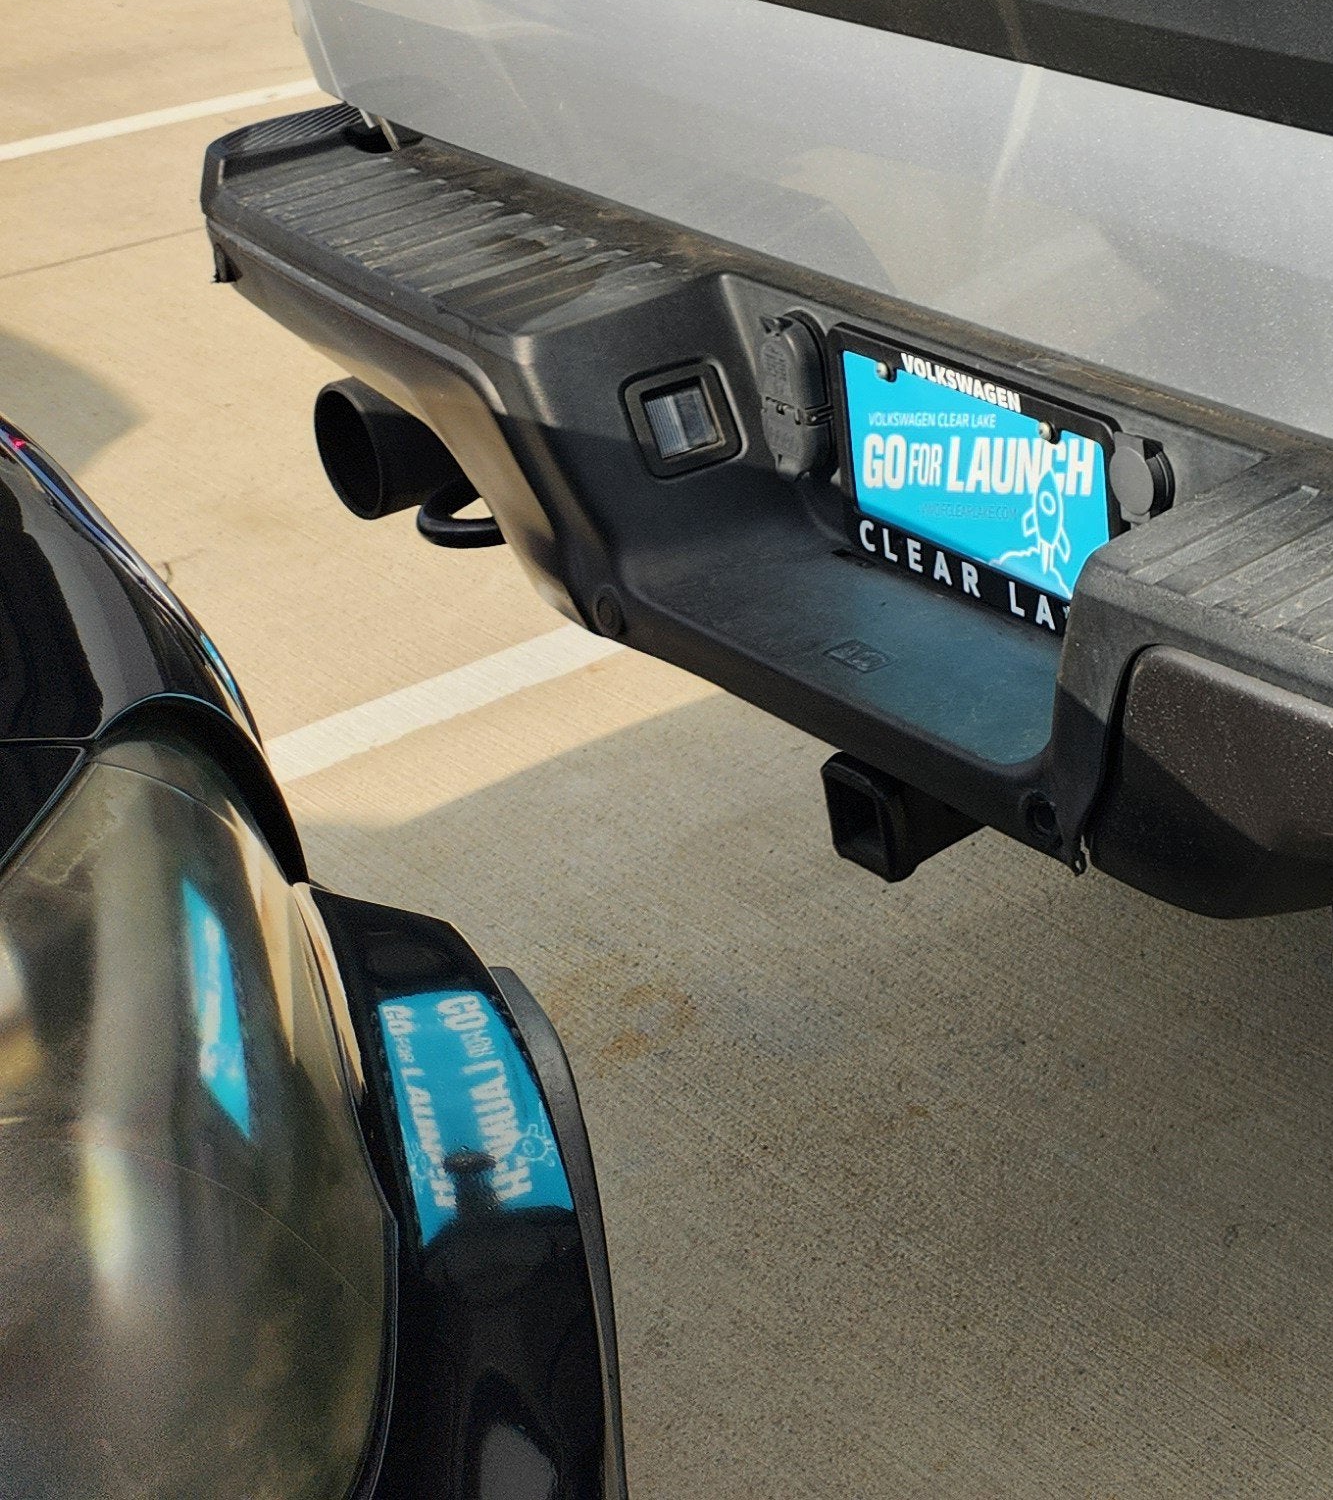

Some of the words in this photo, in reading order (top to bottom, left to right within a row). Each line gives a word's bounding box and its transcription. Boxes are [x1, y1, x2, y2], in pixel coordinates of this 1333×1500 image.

[900, 352, 1022, 413] VOLKSWAGEN
[868, 411, 937, 428] VOLKSWAGEN
[937, 413, 969, 428] CLEAR
[970, 414, 997, 429] LAKE
[863, 433, 907, 490] GO
[907, 442, 943, 488] FOR
[946, 436, 1096, 497] LAUNCH
[858, 518, 982, 599] CLEAR
[1007, 580, 1071, 632] LA
